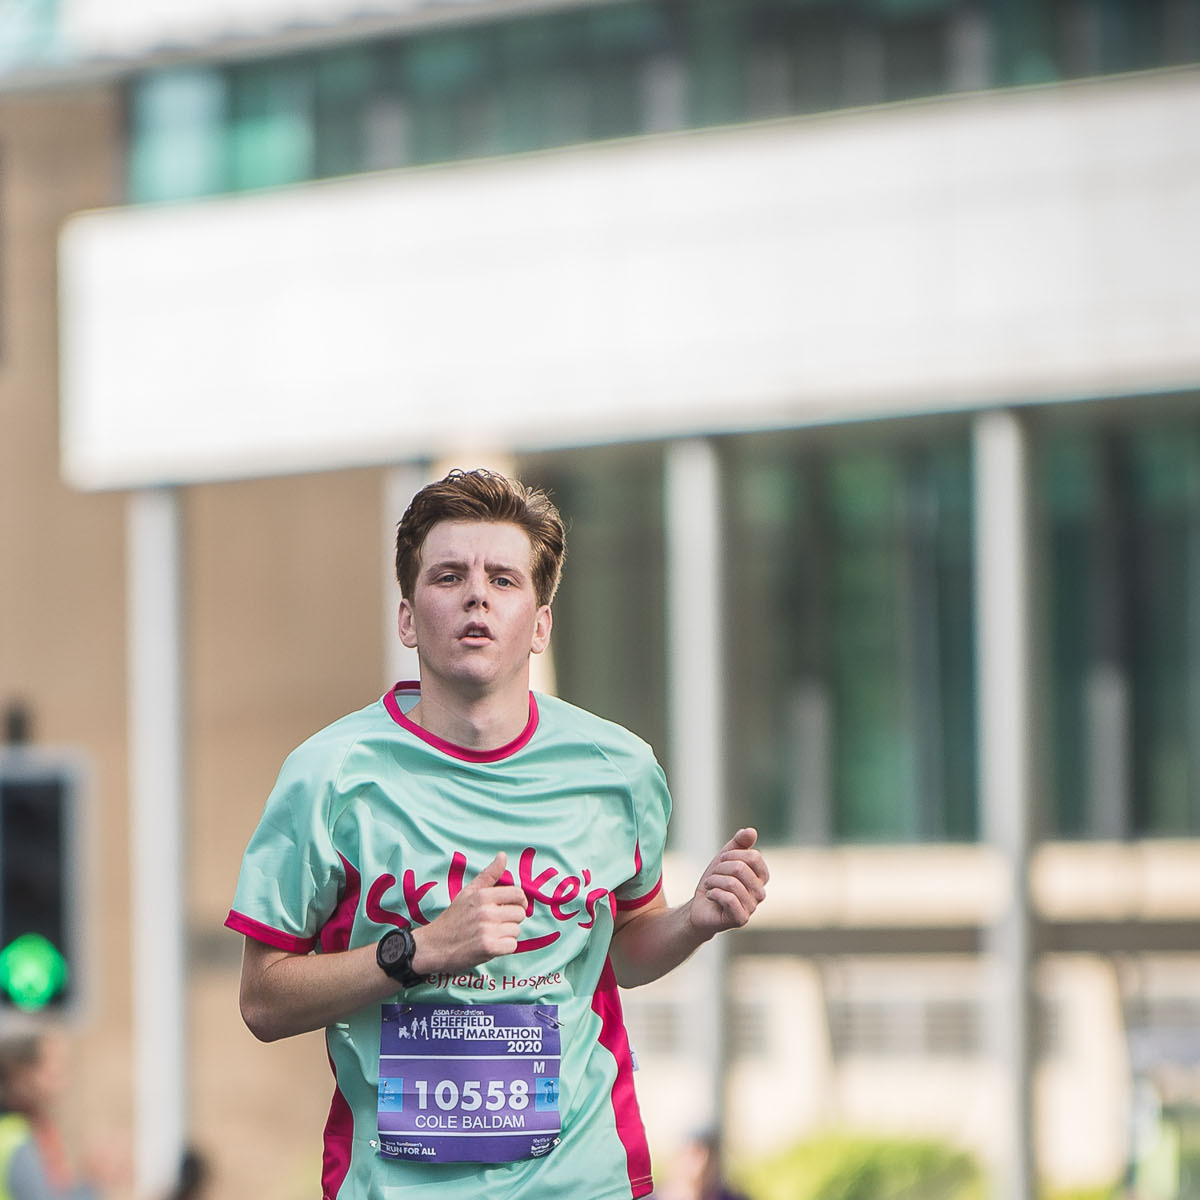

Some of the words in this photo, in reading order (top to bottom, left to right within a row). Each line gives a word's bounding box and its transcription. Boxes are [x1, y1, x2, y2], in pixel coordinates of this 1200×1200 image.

[432, 1016, 492, 1027] SHEFFIELD
[432, 1028, 464, 1039] HALF
[466, 1028, 541, 1040] MARATHON
[507, 1041, 542, 1053] 2020
[533, 1061, 545, 1074] M
[415, 1080, 529, 1111] 10558
[415, 1115, 457, 1129] COLE
[462, 1115, 525, 1129] BALDAM
[386, 1145, 403, 1153] RUN
[403, 1147, 420, 1155] FOR
[421, 1147, 436, 1156] ALL
